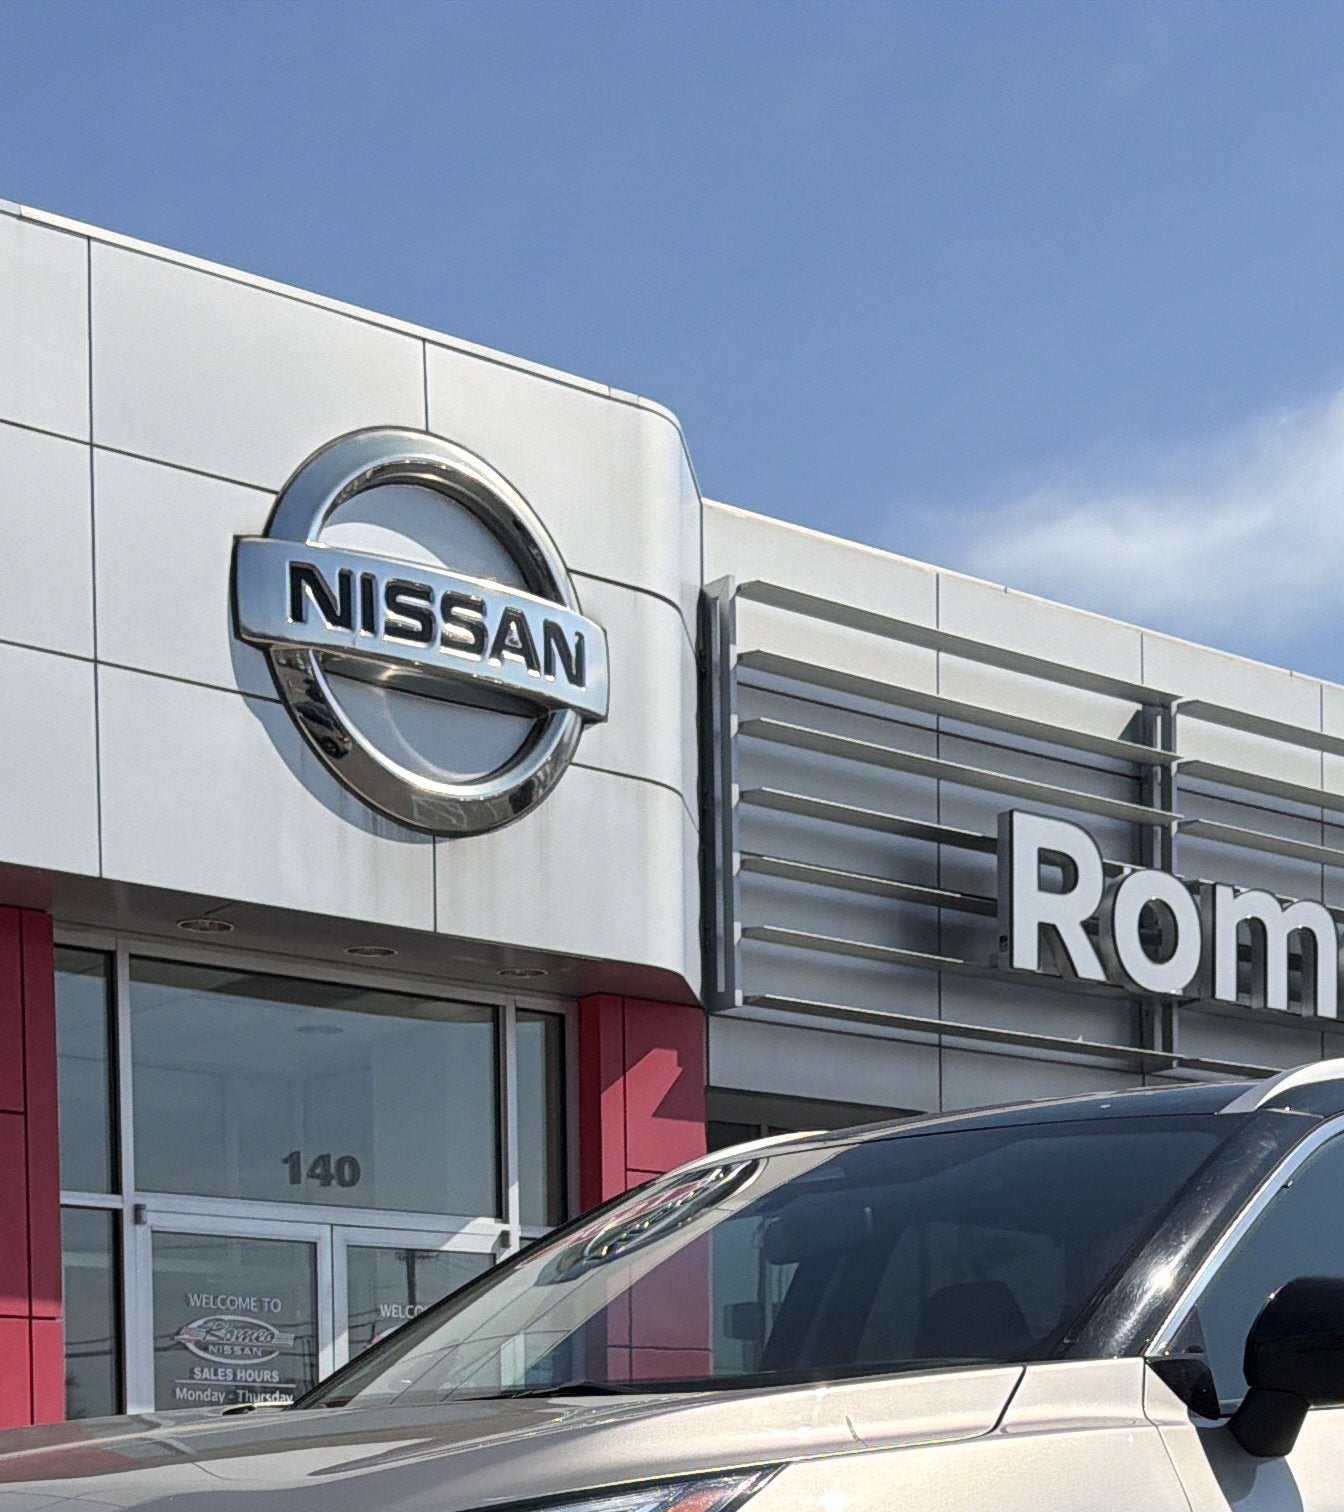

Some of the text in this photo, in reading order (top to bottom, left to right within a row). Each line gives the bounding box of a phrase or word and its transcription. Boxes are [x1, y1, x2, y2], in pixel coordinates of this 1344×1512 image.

[288, 560, 586, 692] NISSAN
[281, 1150, 361, 1188] 140
[189, 1293, 282, 1313] WELCOME TO
[379, 1303, 430, 1319] WELCO
[208, 1344, 262, 1357] NISSAN
[193, 1367, 280, 1383] SALES HOURS
[175, 1387, 225, 1404] Monday
[236, 1389, 294, 1403] Thursday
